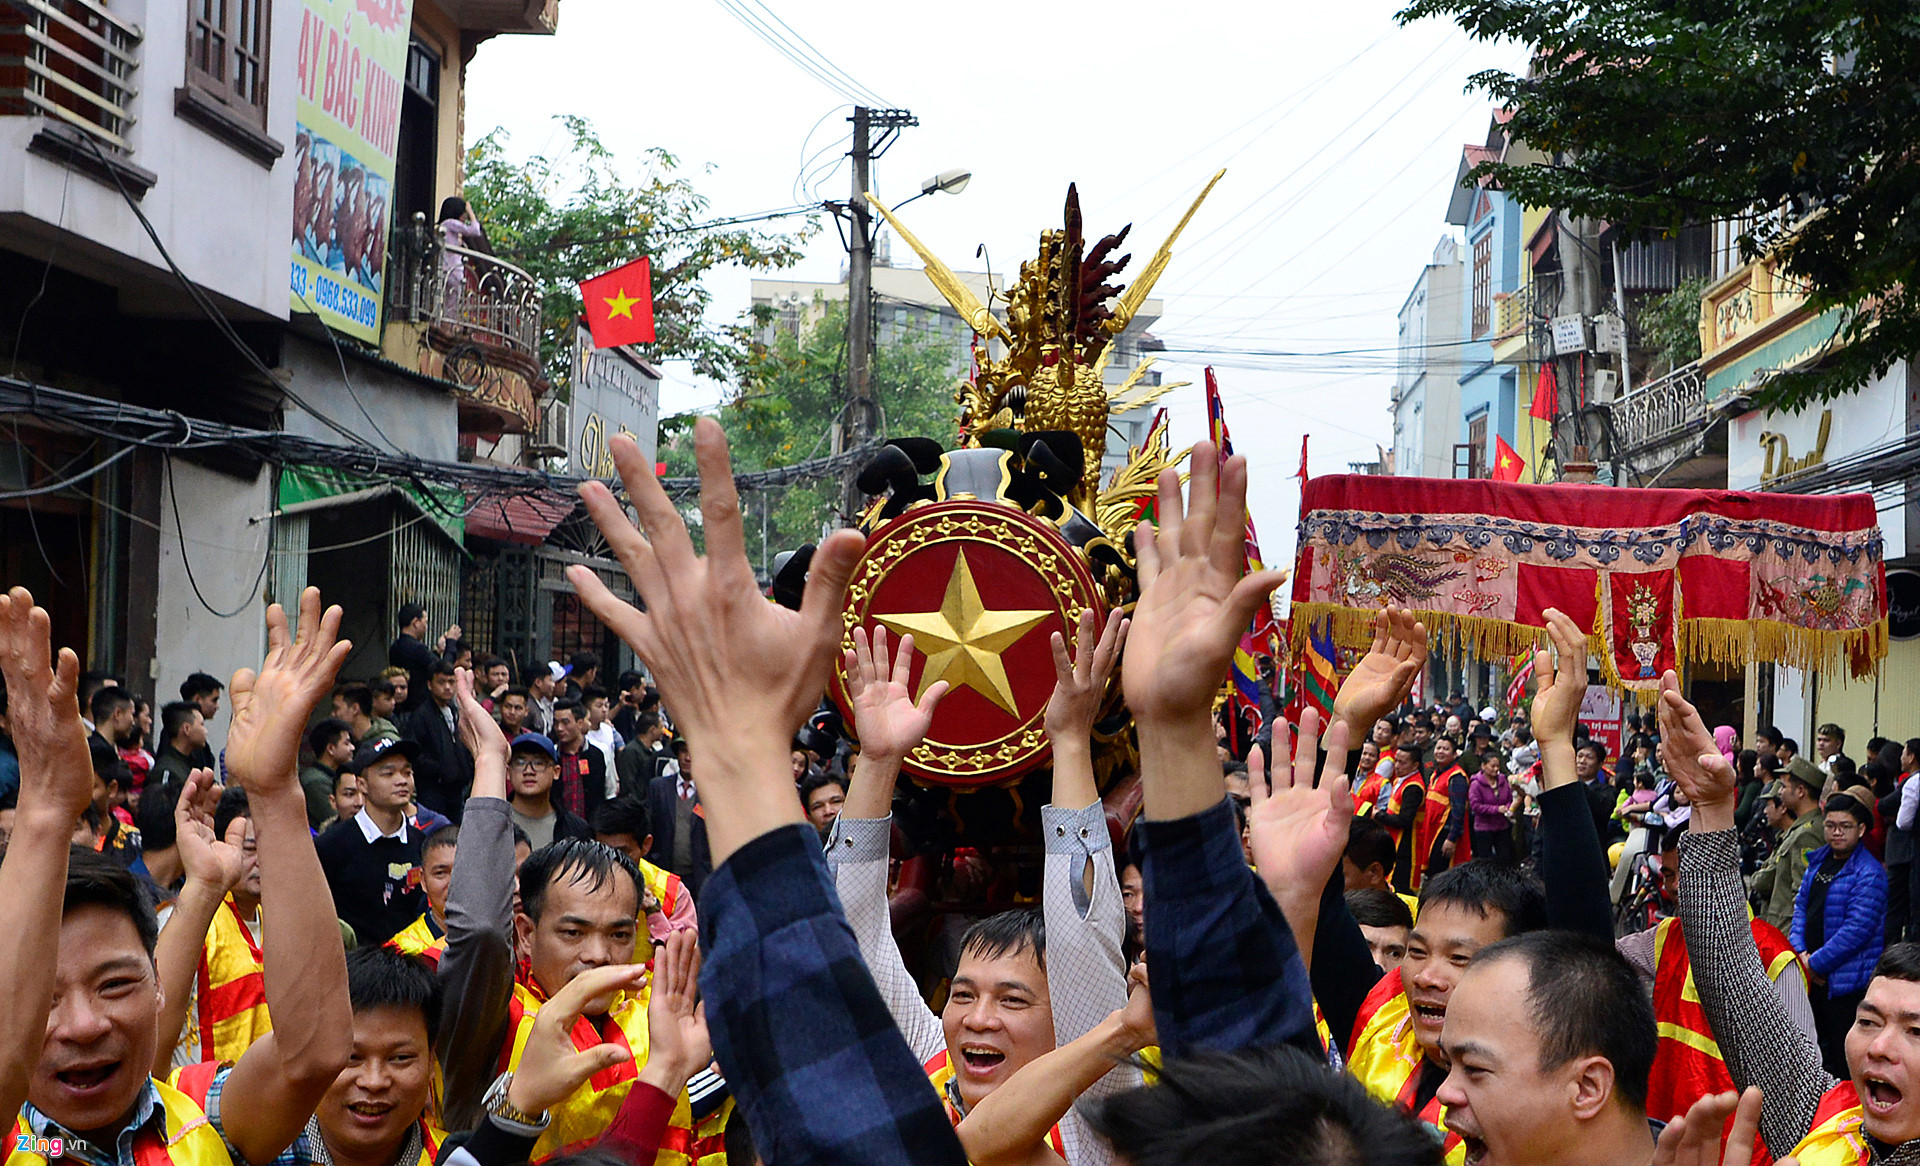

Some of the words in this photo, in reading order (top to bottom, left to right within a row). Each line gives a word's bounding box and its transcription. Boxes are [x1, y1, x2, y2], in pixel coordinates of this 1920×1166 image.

[323, 11, 361, 129] BẮC
[361, 58, 399, 158] KINH
[315, 275, 376, 328] 0968.533.099
